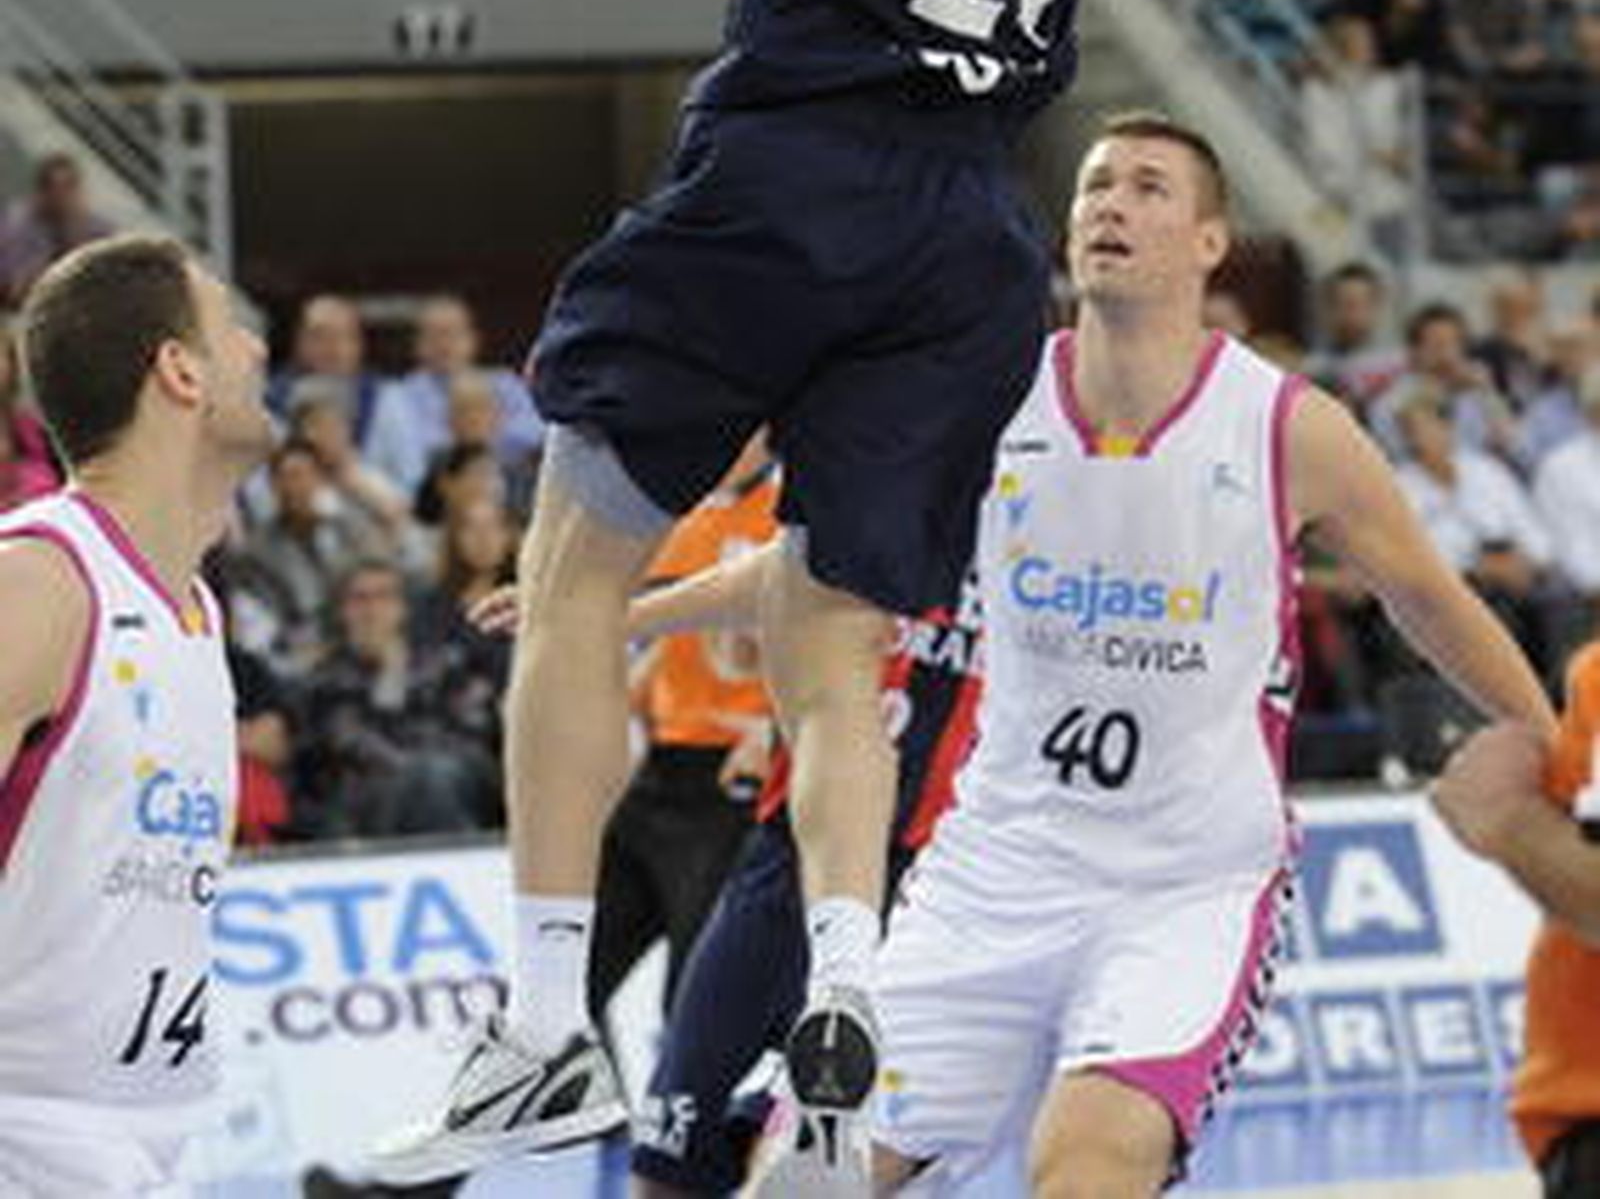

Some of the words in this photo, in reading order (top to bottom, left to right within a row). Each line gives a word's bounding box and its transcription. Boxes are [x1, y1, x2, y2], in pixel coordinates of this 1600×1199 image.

[1010, 556, 1220, 630] Cajasol
[1041, 706, 1141, 789] 40
[210, 878, 496, 985] STA
[119, 967, 208, 1067] 14
